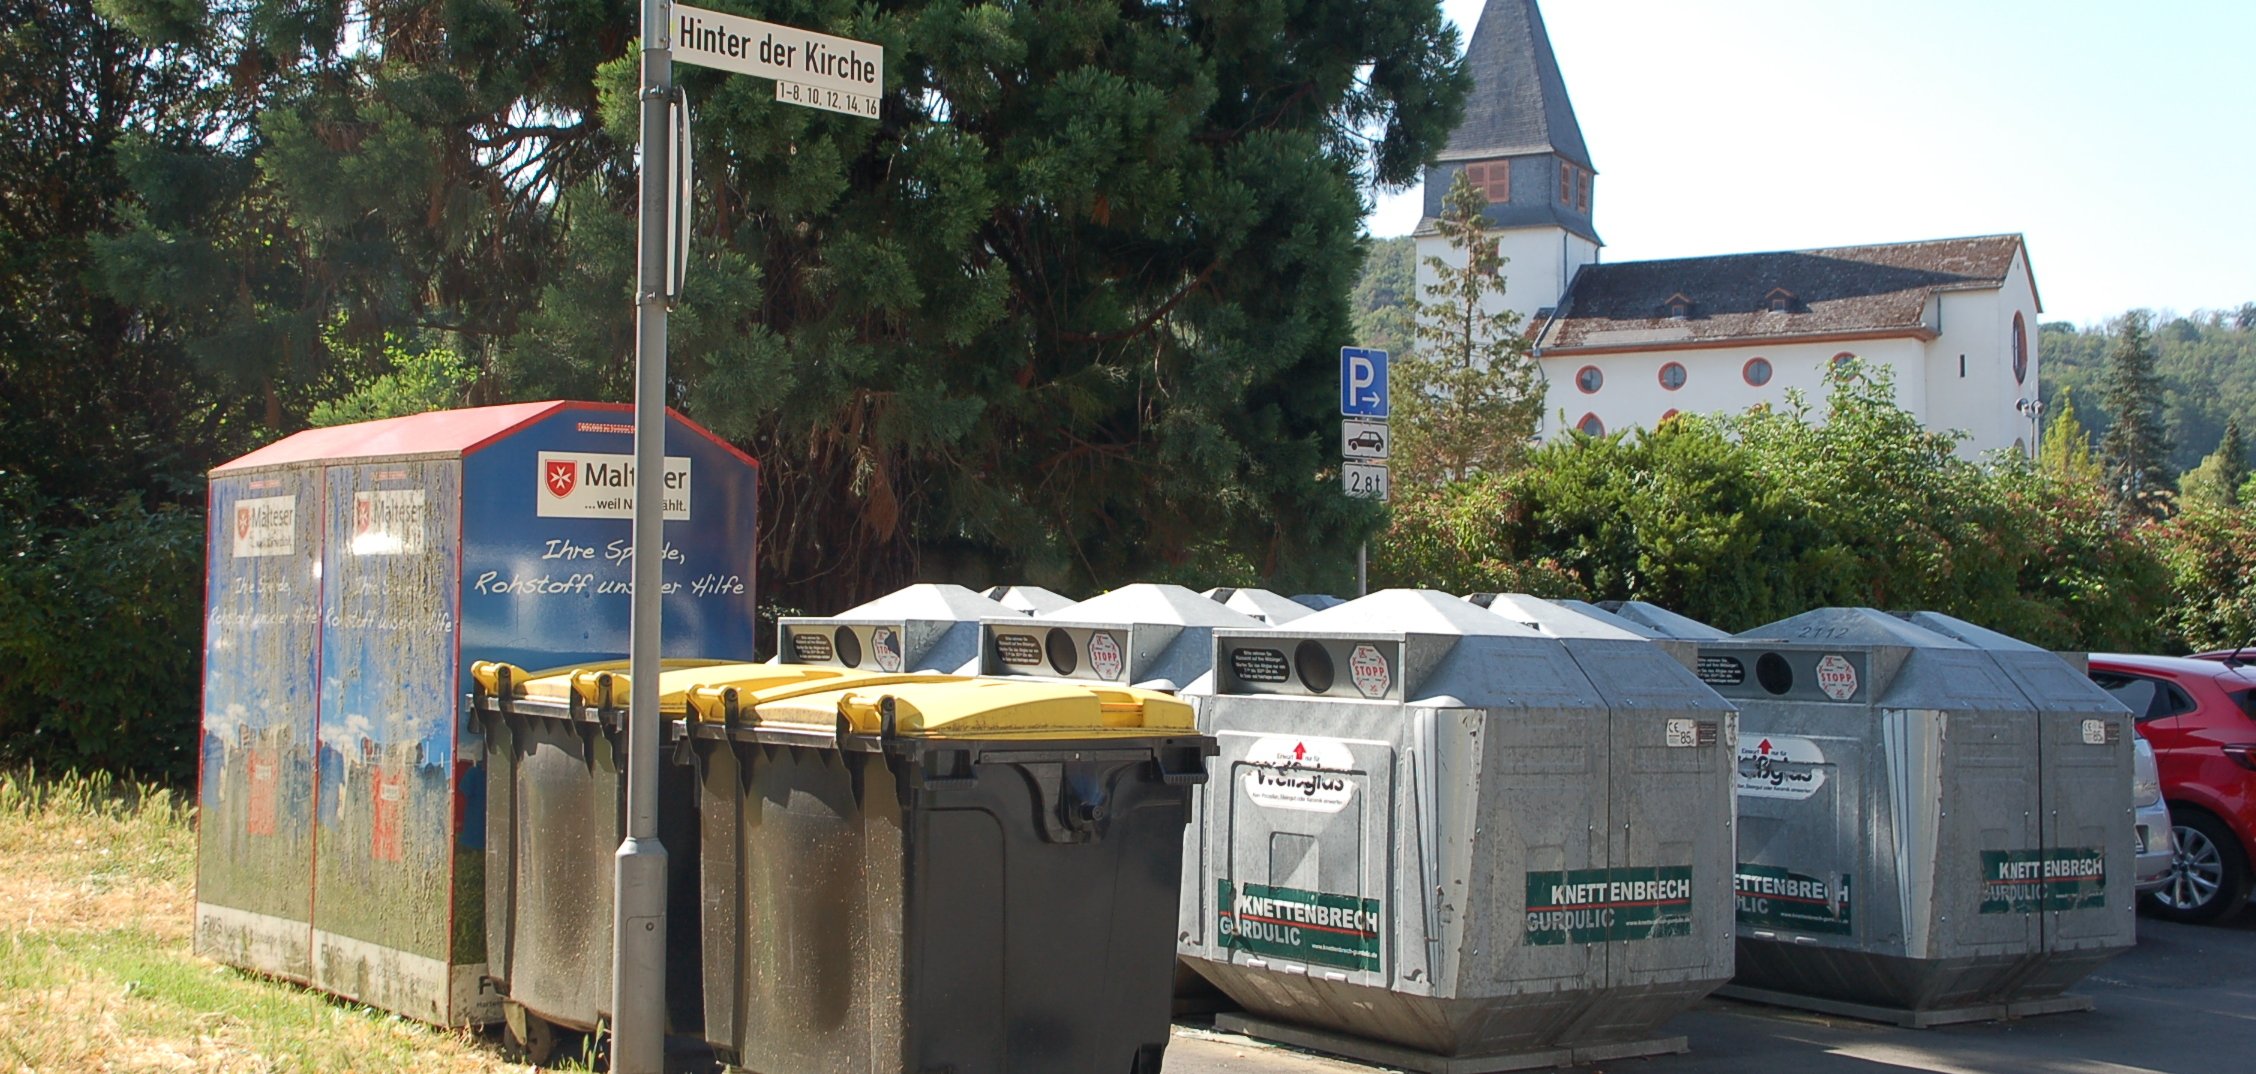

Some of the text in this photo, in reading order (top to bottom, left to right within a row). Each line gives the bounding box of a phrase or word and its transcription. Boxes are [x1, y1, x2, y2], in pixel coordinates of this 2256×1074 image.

[680, 16, 875, 84] Hinter der Kirche
[866, 99, 877, 115] 16
[1350, 357, 1375, 406] P
[585, 462, 687, 489] Malter
[252, 505, 293, 529] Malteser
[374, 499, 424, 525] Malteser
[542, 540, 686, 566] Ihre Spde,
[474, 571, 744, 597] Rohstoff unser Hilfe
[1798, 626, 1848, 639] 2112
[1094, 652, 1117, 661] STOPP
[1355, 665, 1385, 677] STOPP
[1821, 672, 1852, 682] STOPP
[1999, 858, 2103, 879] KNETTENBRECH
[1551, 879, 1690, 905] KNETTENBRECH
[1735, 873, 1849, 902] ETTENBREH
[1241, 895, 1378, 933] KNETTENBRECH
[1219, 915, 1301, 946] GRDULIC
